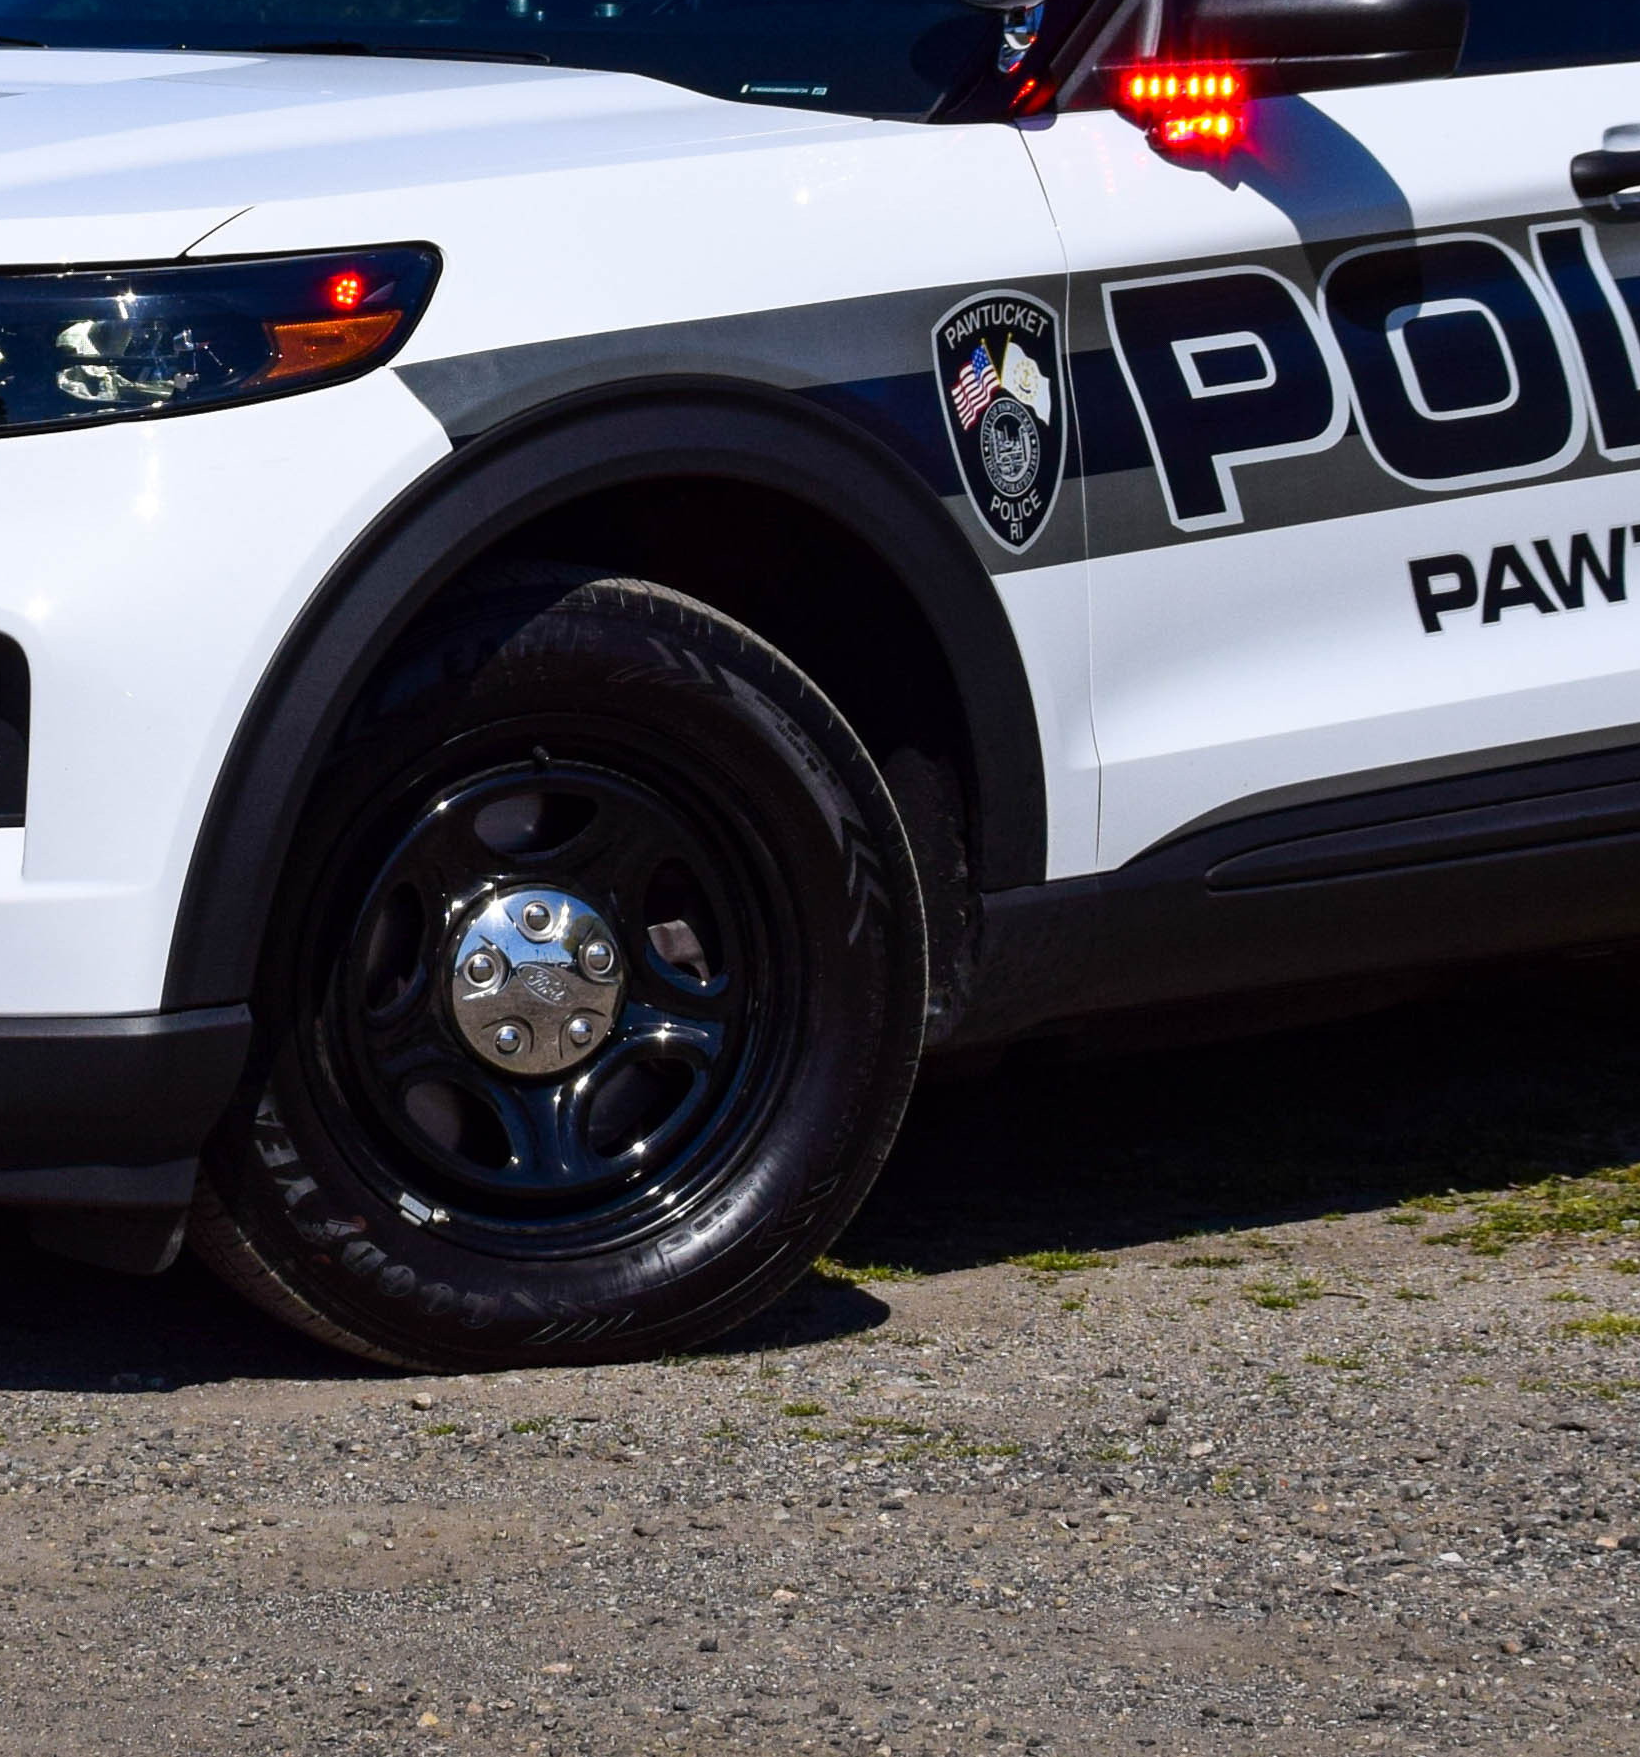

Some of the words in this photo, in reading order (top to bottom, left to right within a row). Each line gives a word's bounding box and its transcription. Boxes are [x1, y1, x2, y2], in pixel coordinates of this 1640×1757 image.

[944, 302, 1050, 350] PAWTUCKET
[990, 488, 1043, 522] POLICE
[1010, 522, 1023, 540] RI
